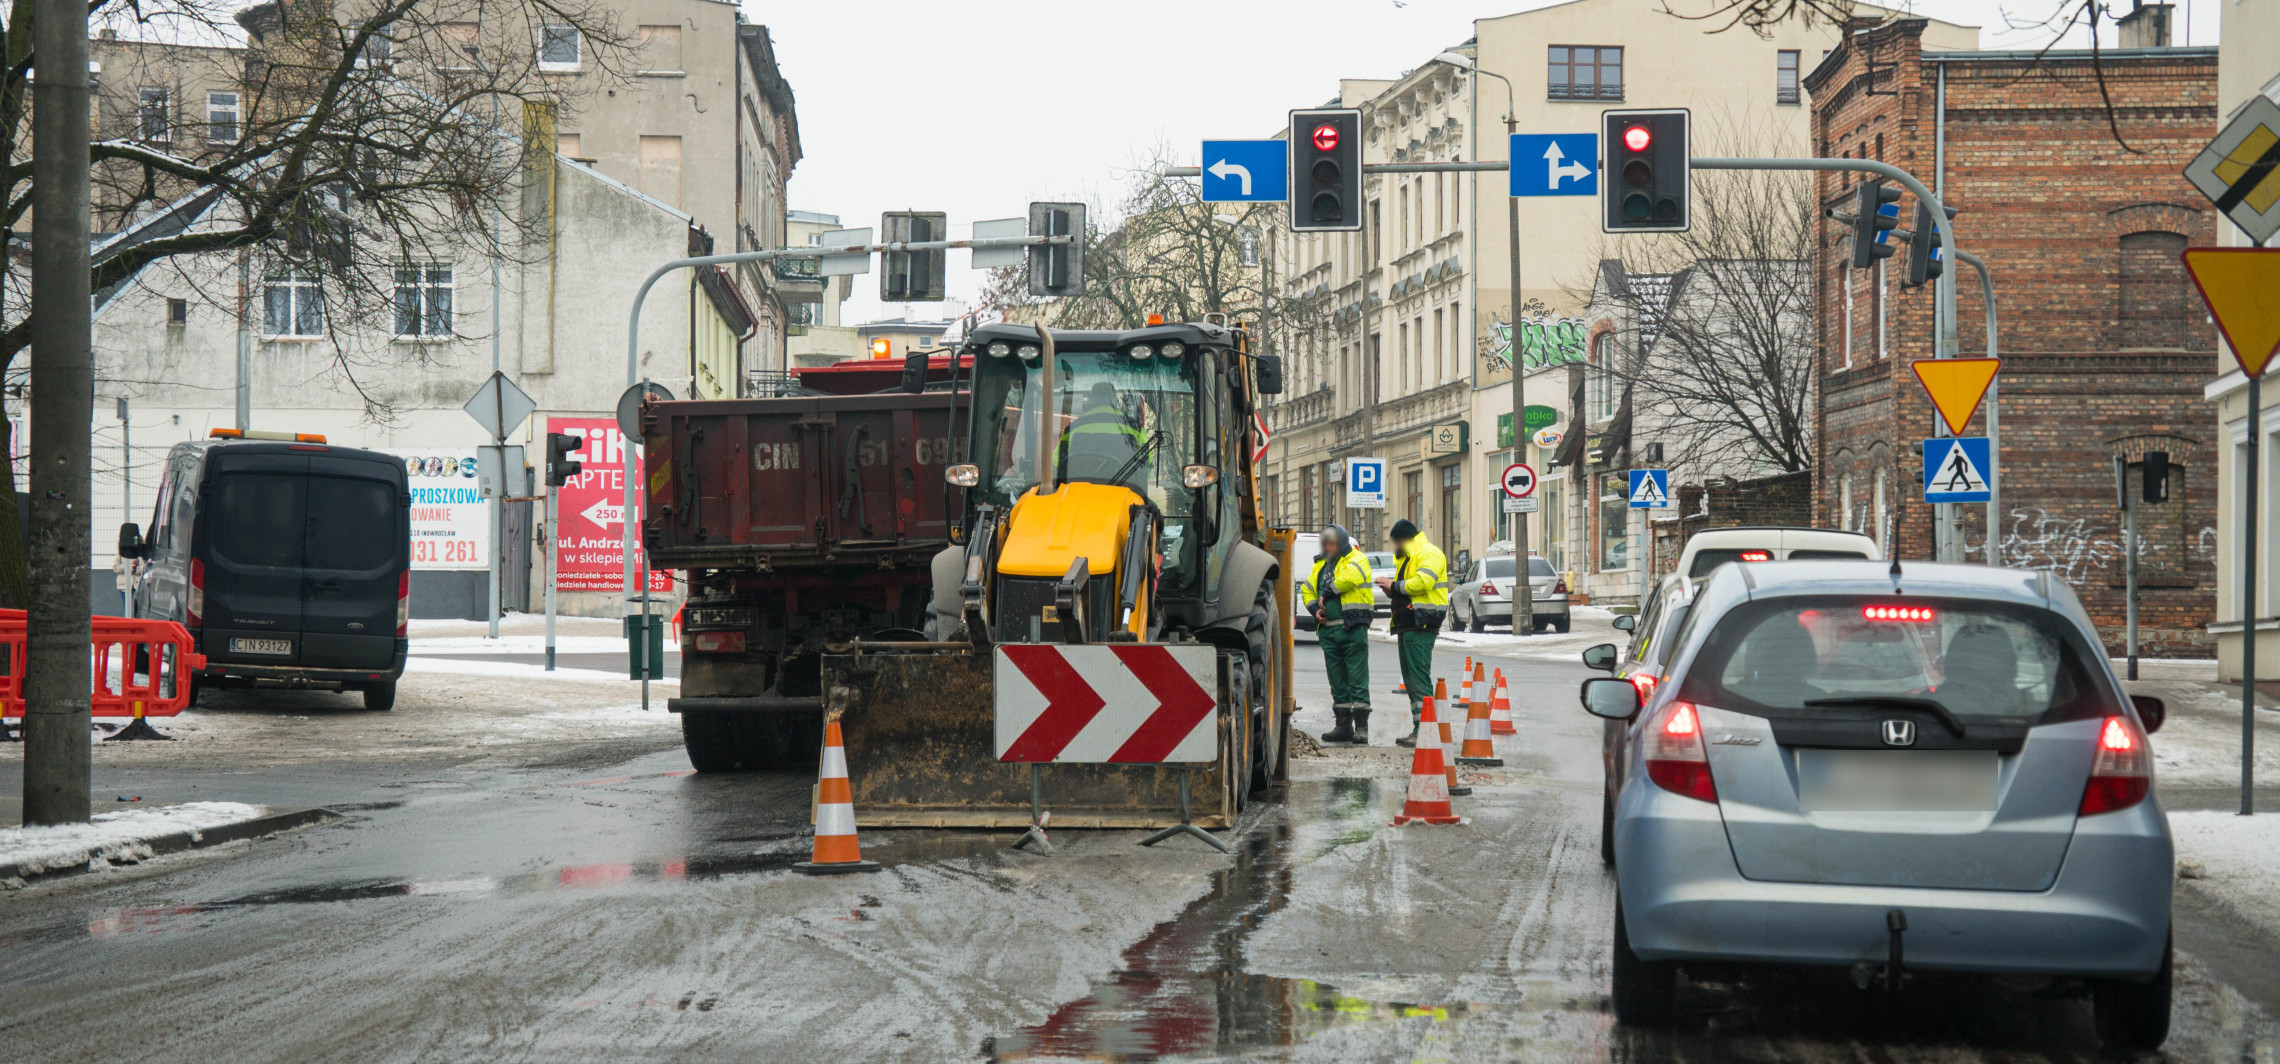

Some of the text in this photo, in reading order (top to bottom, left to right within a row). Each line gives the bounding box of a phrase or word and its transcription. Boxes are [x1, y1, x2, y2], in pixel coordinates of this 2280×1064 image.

[1525, 411, 1553, 420] abka
[563, 428, 643, 463] Zik
[754, 442, 799, 471] CIN
[859, 439, 889, 467] 51
[562, 469, 643, 489] APTE
[1358, 466, 1375, 489] P
[411, 508, 452, 522] OWANIE
[596, 509, 618, 519] 250
[558, 537, 640, 549] ul. Andrza
[445, 540, 478, 562] 261
[565, 554, 576, 563] w
[579, 552, 624, 566] sklepie
[556, 571, 624, 580] oniedziałek-sobo
[236, 639, 289, 652] CIN 93127
[1712, 734, 1763, 746] Jazz
